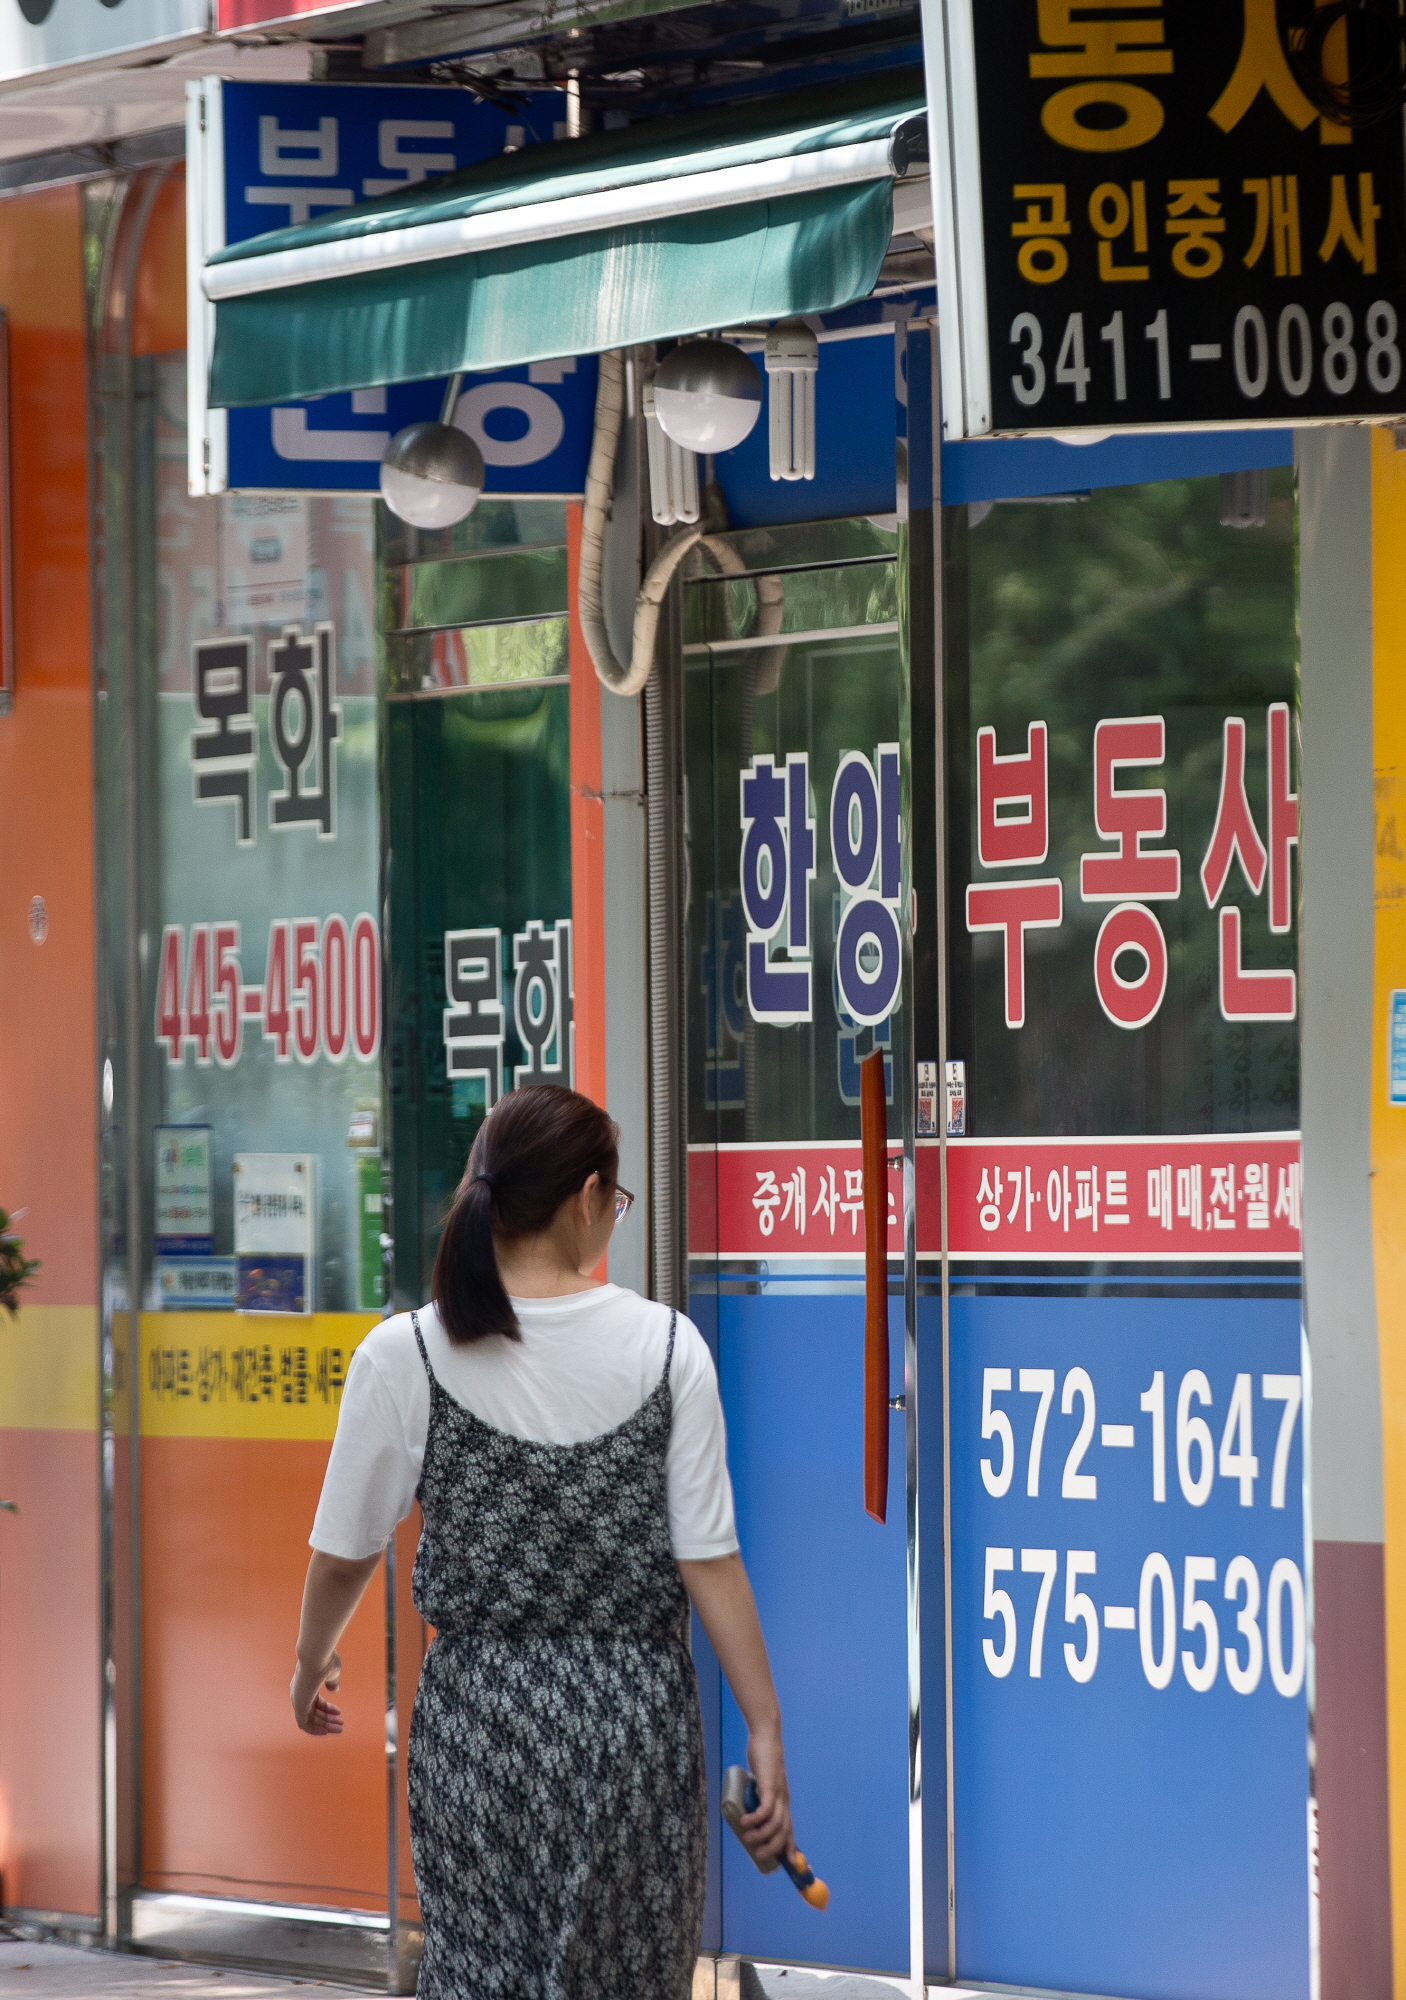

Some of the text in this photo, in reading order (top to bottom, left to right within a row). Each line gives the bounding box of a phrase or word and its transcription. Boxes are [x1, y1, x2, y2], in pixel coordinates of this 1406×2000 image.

[1011, 172, 1381, 284] 공인중개사
[1009, 299, 1402, 407] 3411-0088
[191, 620, 343, 848] 목화
[965, 702, 1298, 1030] 부동산
[156, 911, 382, 1069] 445-4500
[980, 1366, 1303, 1509] 572-1647
[982, 1547, 1306, 1698] 575-0530
